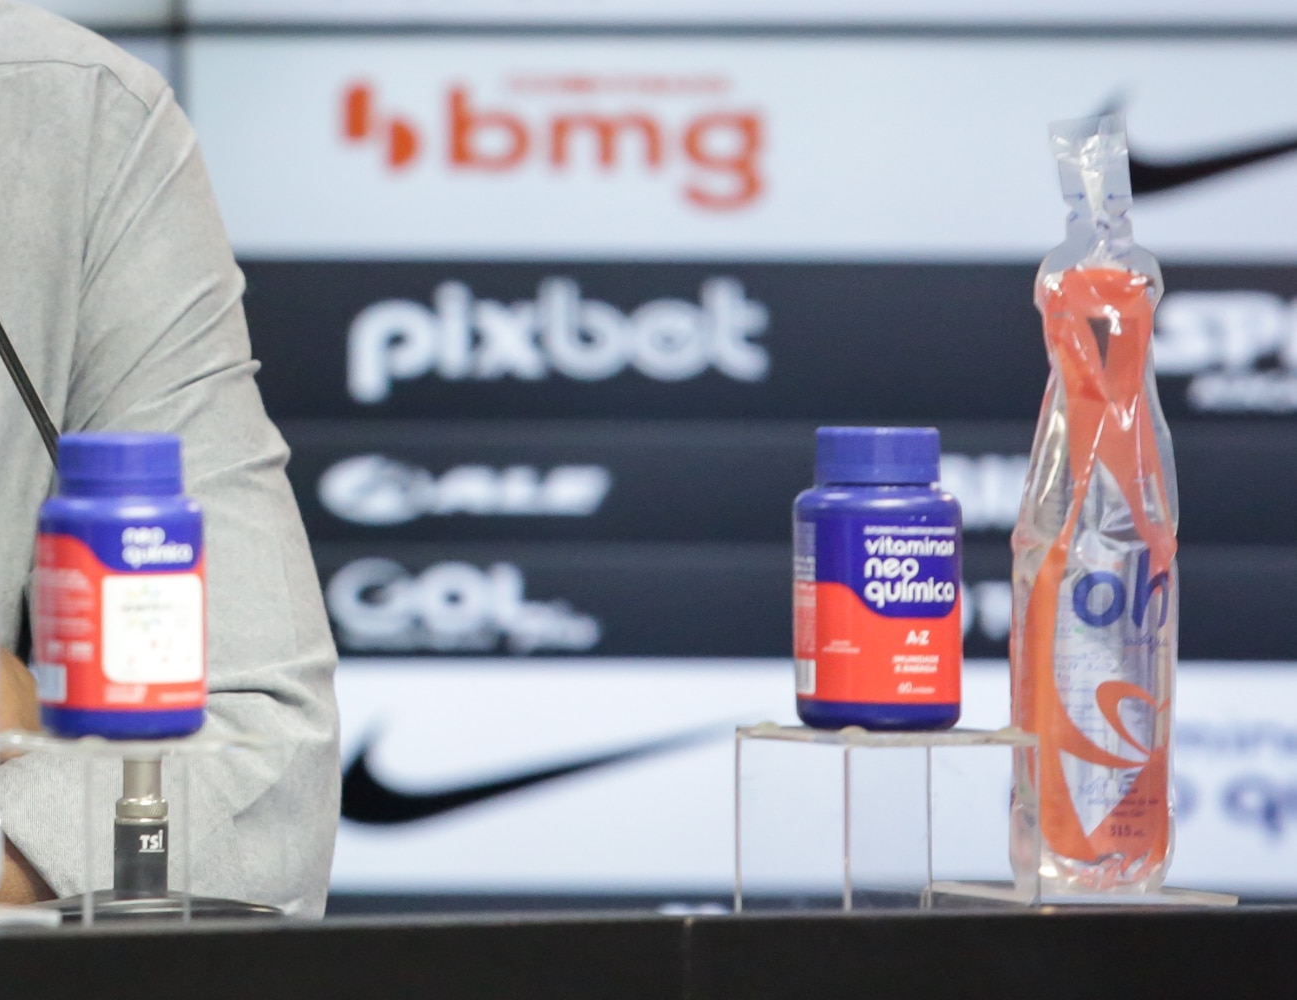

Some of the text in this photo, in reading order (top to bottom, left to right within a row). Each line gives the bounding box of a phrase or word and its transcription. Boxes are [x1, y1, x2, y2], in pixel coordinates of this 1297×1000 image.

[447, 82, 765, 214] bmg
[347, 275, 771, 402] pixbet
[863, 557, 920, 579] neo
[1072, 548, 1169, 629] oh
